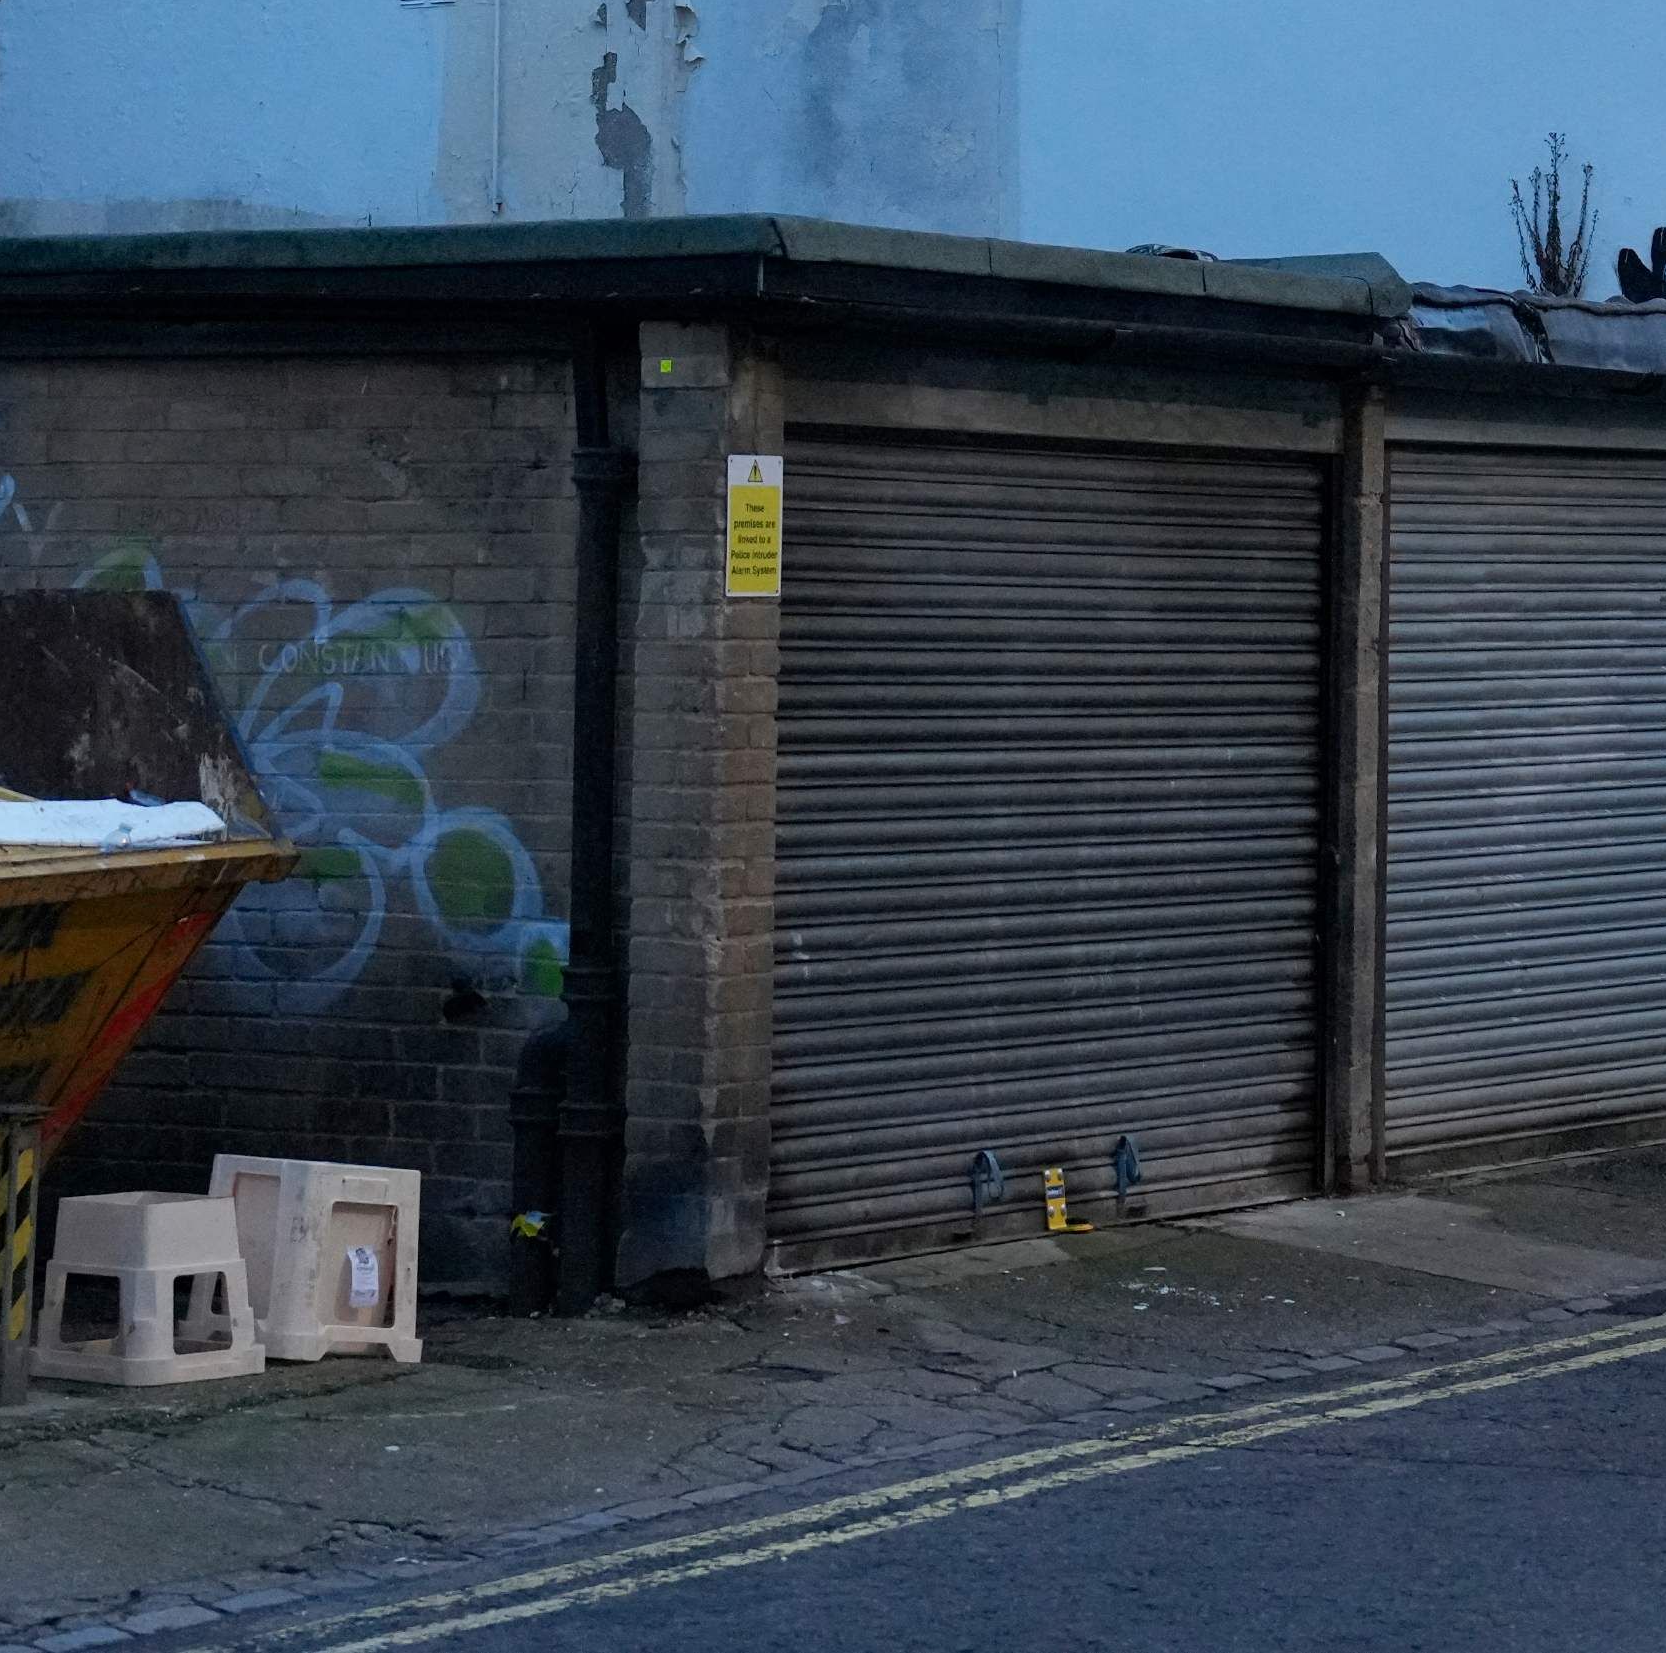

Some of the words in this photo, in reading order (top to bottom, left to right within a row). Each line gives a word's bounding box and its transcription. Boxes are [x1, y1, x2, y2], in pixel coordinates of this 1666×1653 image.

[745, 503, 765, 513] These
[733, 519, 764, 531] premises
[737, 534, 758, 544] linked
[759, 535, 766, 544] to
[731, 550, 751, 559] Police
[731, 566, 751, 575] Alarm
[752, 566, 777, 577] System
